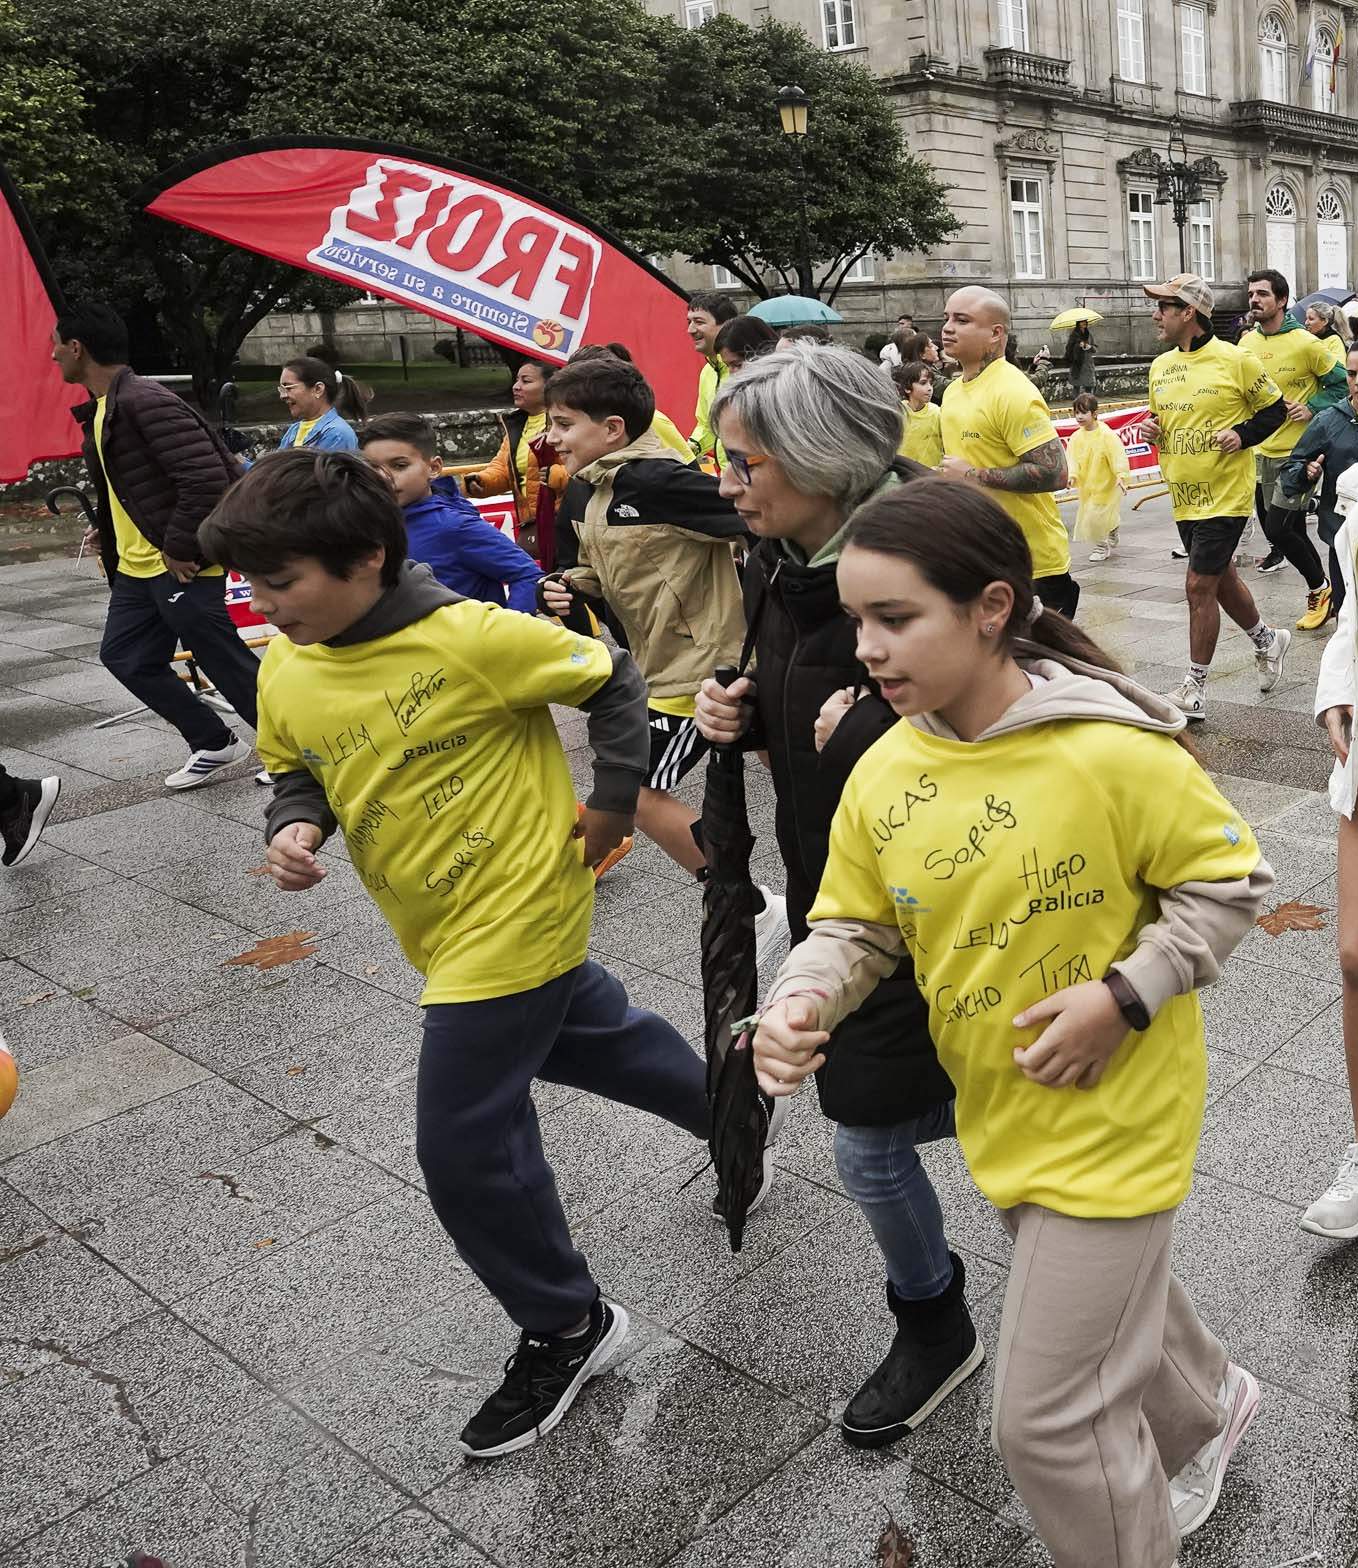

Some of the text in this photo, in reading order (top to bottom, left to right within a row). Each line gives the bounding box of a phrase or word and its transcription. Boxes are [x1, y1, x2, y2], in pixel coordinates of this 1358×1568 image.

[387, 734, 468, 771] galicia
[422, 775, 464, 819] LELO
[873, 773, 938, 856] LUCAS
[1018, 848, 1086, 894] HUGO
[1009, 889, 1105, 925] galicia
